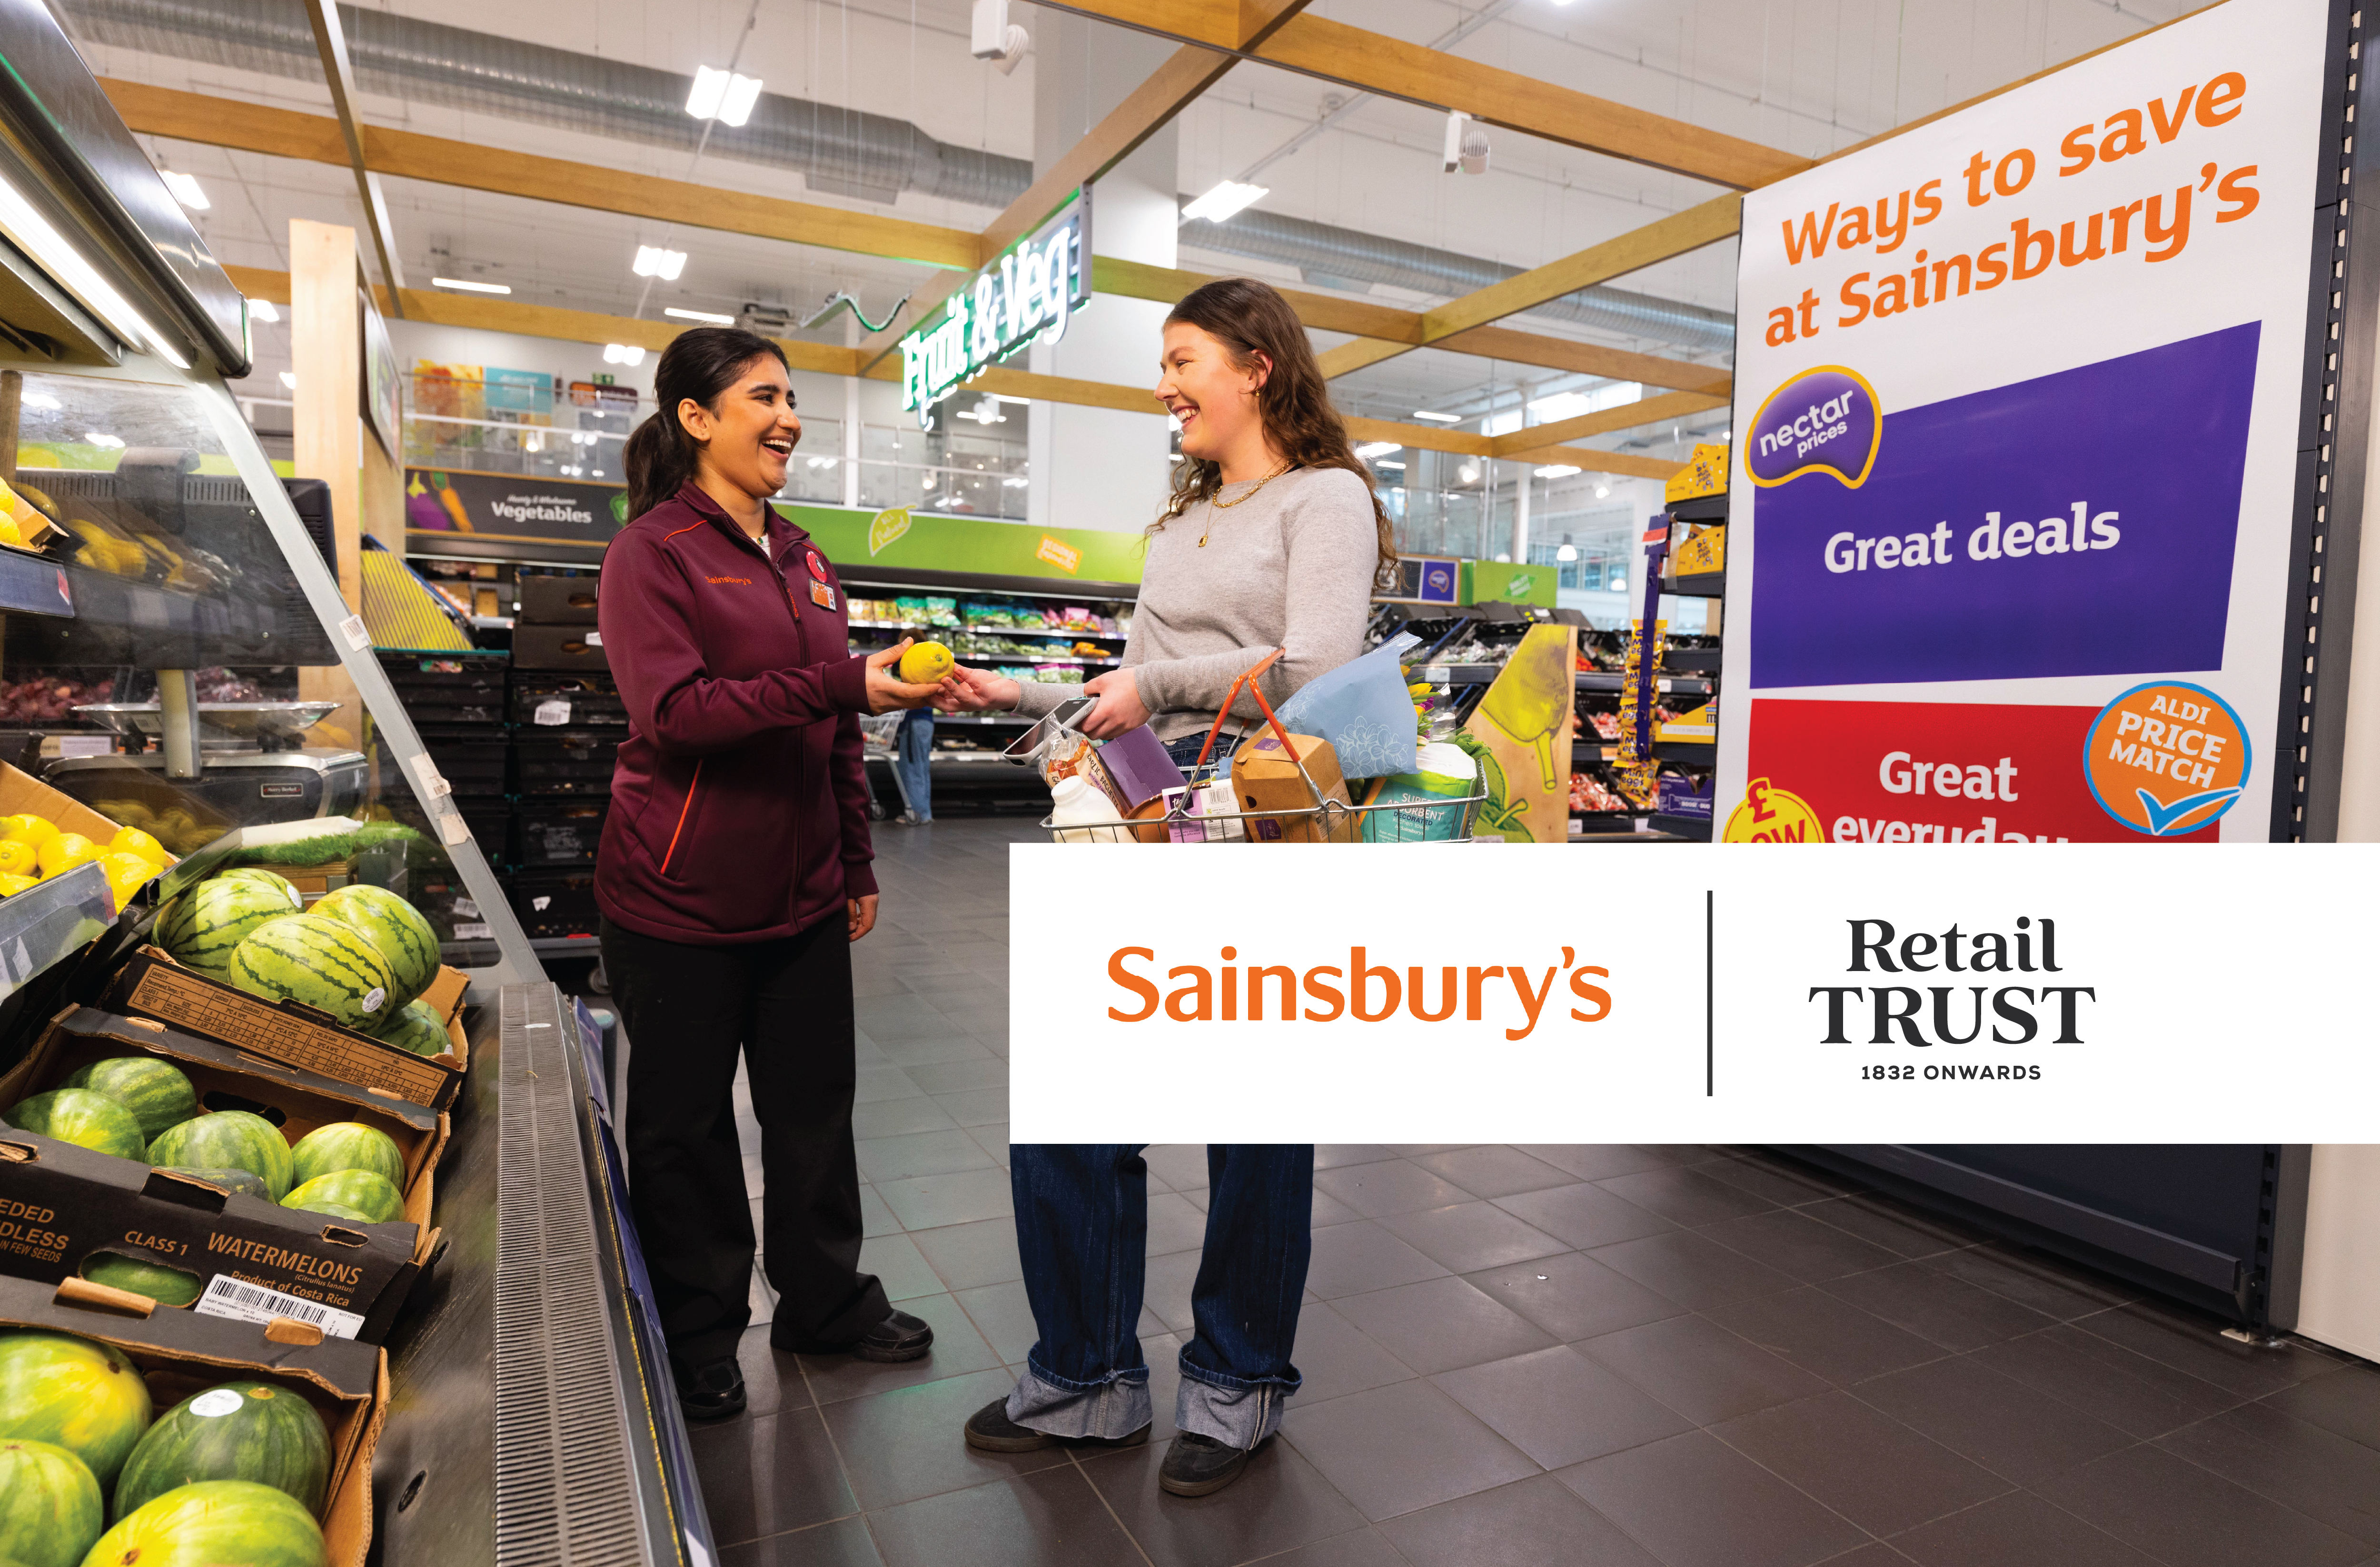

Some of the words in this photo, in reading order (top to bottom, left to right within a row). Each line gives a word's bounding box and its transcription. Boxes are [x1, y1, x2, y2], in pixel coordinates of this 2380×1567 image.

[1782, 179, 1942, 266] Ways
[1963, 149, 2035, 207] to
[2059, 72, 2246, 177] save
[1765, 288, 1820, 347] at
[1838, 162, 2260, 327] Sainsbury's
[899, 293, 969, 412] Fruit
[972, 274, 1000, 361] &
[1001, 227, 1071, 346] Veg
[1760, 390, 1853, 457] nectar
[1797, 421, 1847, 458] prices
[491, 500, 592, 523] Vegetables
[1825, 521, 1953, 574] Great
[1968, 501, 2121, 561] deals
[705, 576, 752, 585] Sainsbury's
[2150, 694, 2211, 725] ALDI
[2117, 710, 2227, 764] PRICE
[1879, 752, 2018, 802] Great
[2109, 738, 2216, 789] MATCH
[1100, 776, 1118, 808] BAGUETTE
[1748, 780, 1776, 824] £
[1388, 799, 1445, 821] AORBENT
[1393, 811, 1433, 826] DECORATED
[1393, 818, 1412, 827] kichen
[1401, 826, 1424, 835] Sainsbury's
[1833, 816, 2068, 843] everd
[143, 986, 156, 994] CLASS
[152, 971, 169, 980] VARIETY
[215, 994, 228, 1002] SEEDED
[243, 1005, 260, 1015] SEEDLESS
[289, 1003, 319, 1017] International
[319, 1014, 333, 1022] Paper
[0, 1221, 69, 1250] DLESS
[125, 1230, 177, 1253] CLASS
[180, 1244, 188, 1256] 1
[10, 1242, 32, 1255] FEW
[30, 1247, 62, 1263] SEEDS
[208, 1232, 363, 1285] WATERMELONS
[232, 1270, 276, 1289] Product
[278, 1282, 291, 1292] of
[292, 1285, 324, 1300] Costa
[326, 1292, 349, 1307] Rica
[295, 1274, 327, 1287] (Citrullus
[327, 1282, 355, 1293] lanatus)
[218, 1301, 246, 1312] WATERMELON
